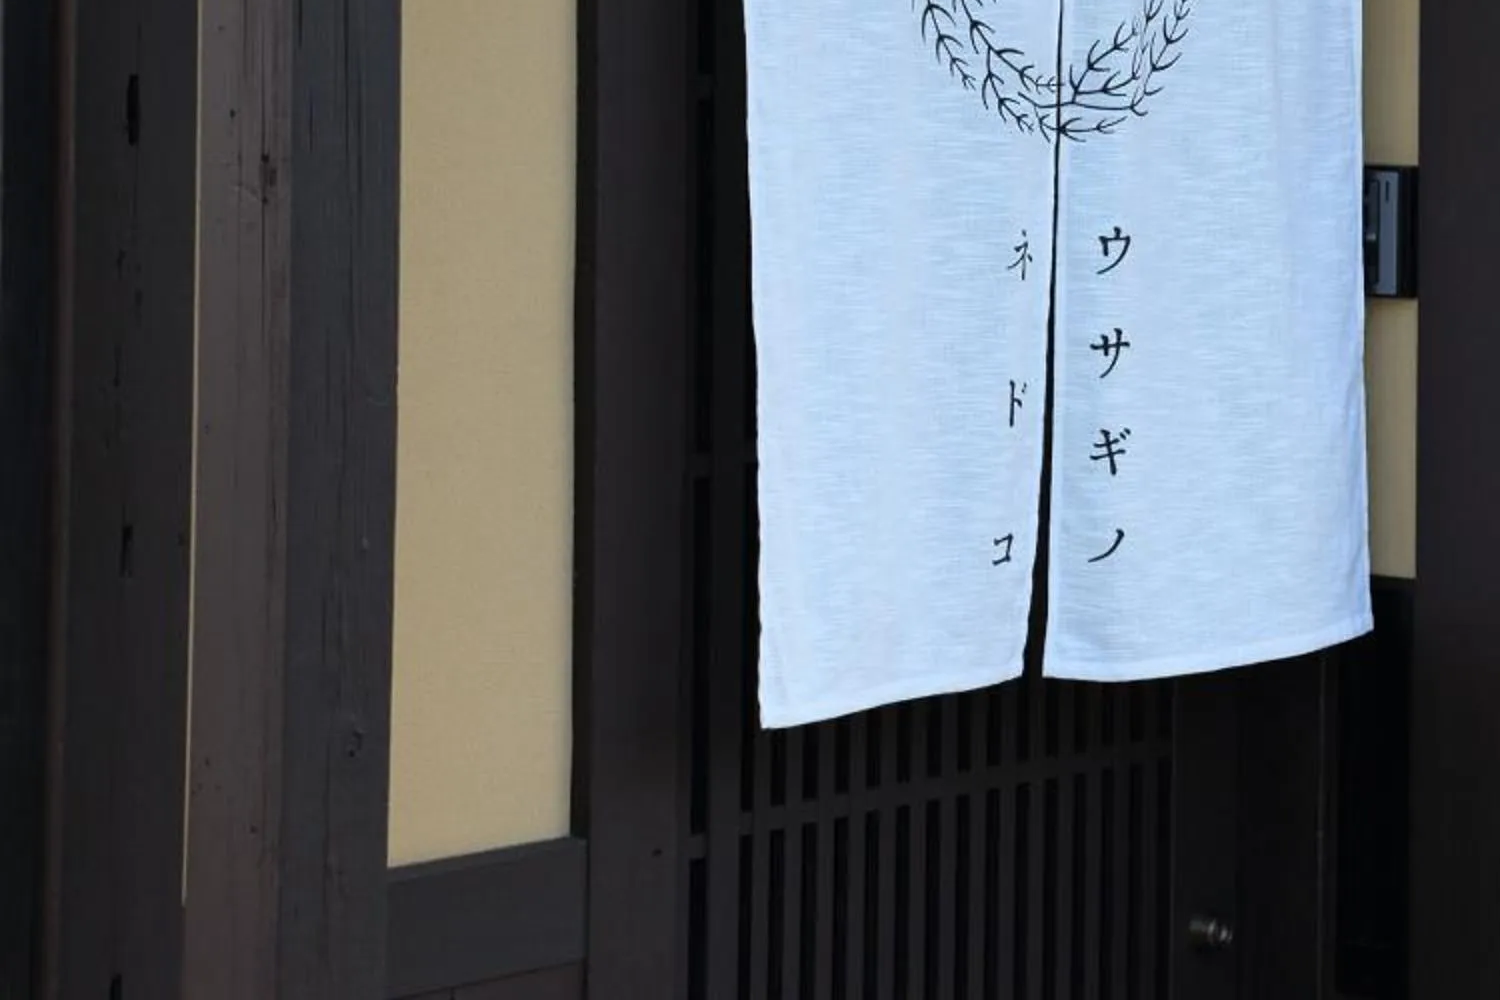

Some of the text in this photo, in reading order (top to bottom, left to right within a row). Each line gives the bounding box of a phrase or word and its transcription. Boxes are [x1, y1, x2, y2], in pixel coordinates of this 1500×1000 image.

[991, 228, 1034, 567] ネドコ
[1086, 225, 1132, 563] ウサギノ
